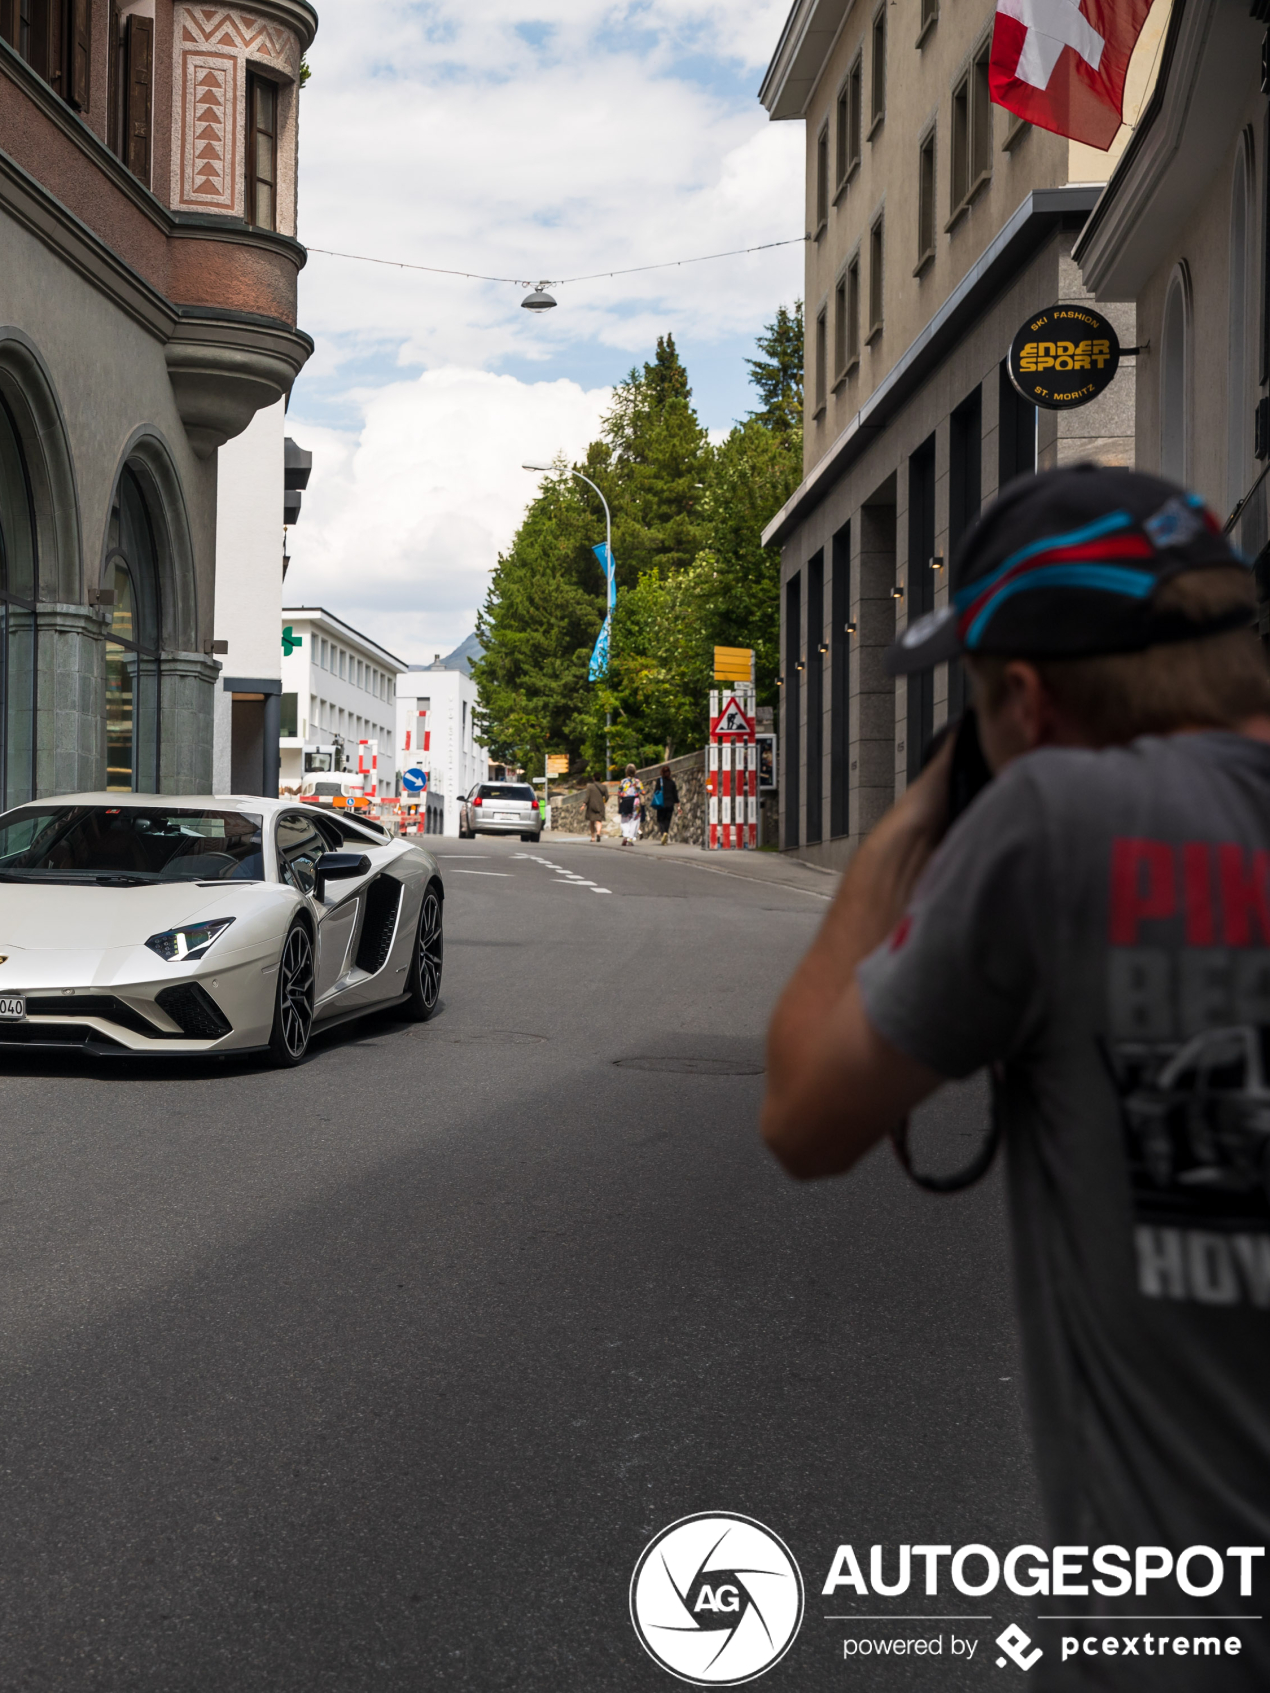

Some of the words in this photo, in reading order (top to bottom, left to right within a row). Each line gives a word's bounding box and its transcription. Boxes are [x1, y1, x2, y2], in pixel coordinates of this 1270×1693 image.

[1031, 316, 1048, 331] SKI
[1053, 311, 1099, 329] FASHION
[1019, 339, 1110, 357] ENDER
[1019, 354, 1110, 372] SPORT
[1034, 386, 1049, 398] ST.
[1053, 384, 1095, 400] MORITZ
